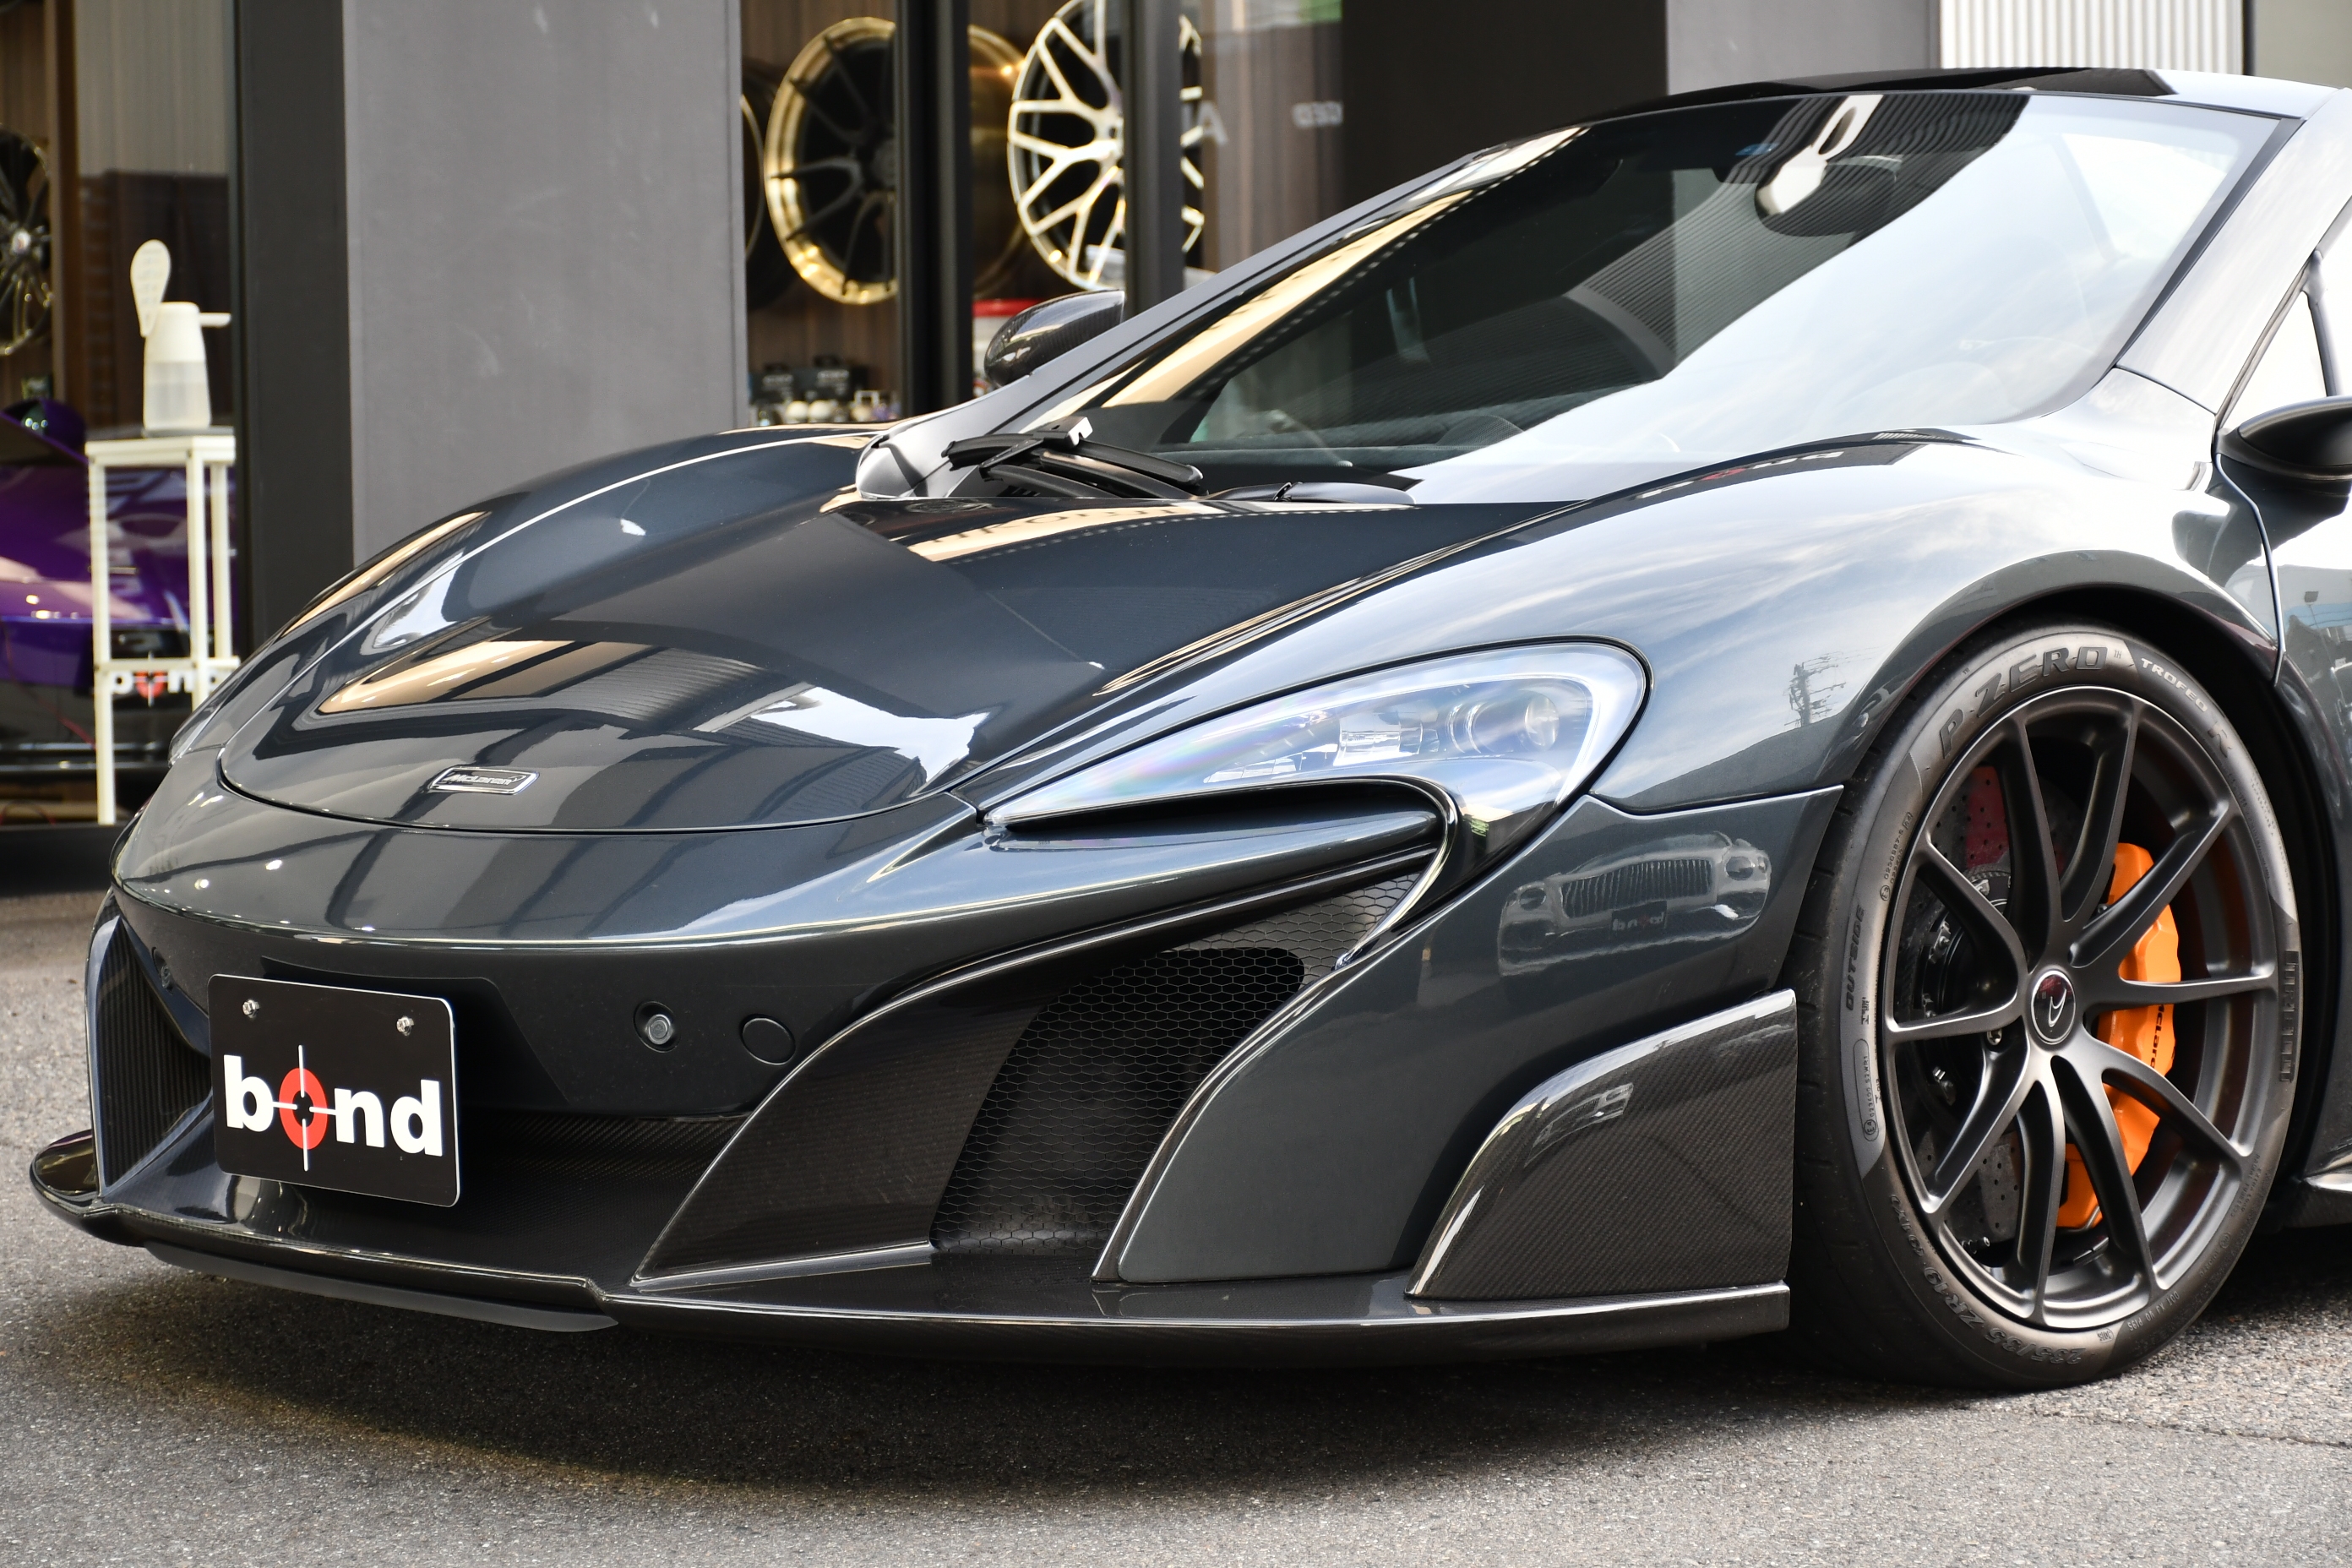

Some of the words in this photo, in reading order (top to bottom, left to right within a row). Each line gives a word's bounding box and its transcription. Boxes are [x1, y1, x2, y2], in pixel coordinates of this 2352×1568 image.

[1940, 708, 1963, 759] P
[1975, 647, 2107, 717] ZERO
[2141, 657, 2208, 712] TROFEO
[2207, 721, 2234, 759] R
[441, 774, 514, 786] McLaren
[1846, 904, 1865, 1011] OUTSIDE
[2150, 1004, 2164, 1069] cLare
[224, 1045, 443, 1171] bond
[2166, 1291, 2180, 1306] DOT
[1985, 1328, 2086, 1364] 235/35
